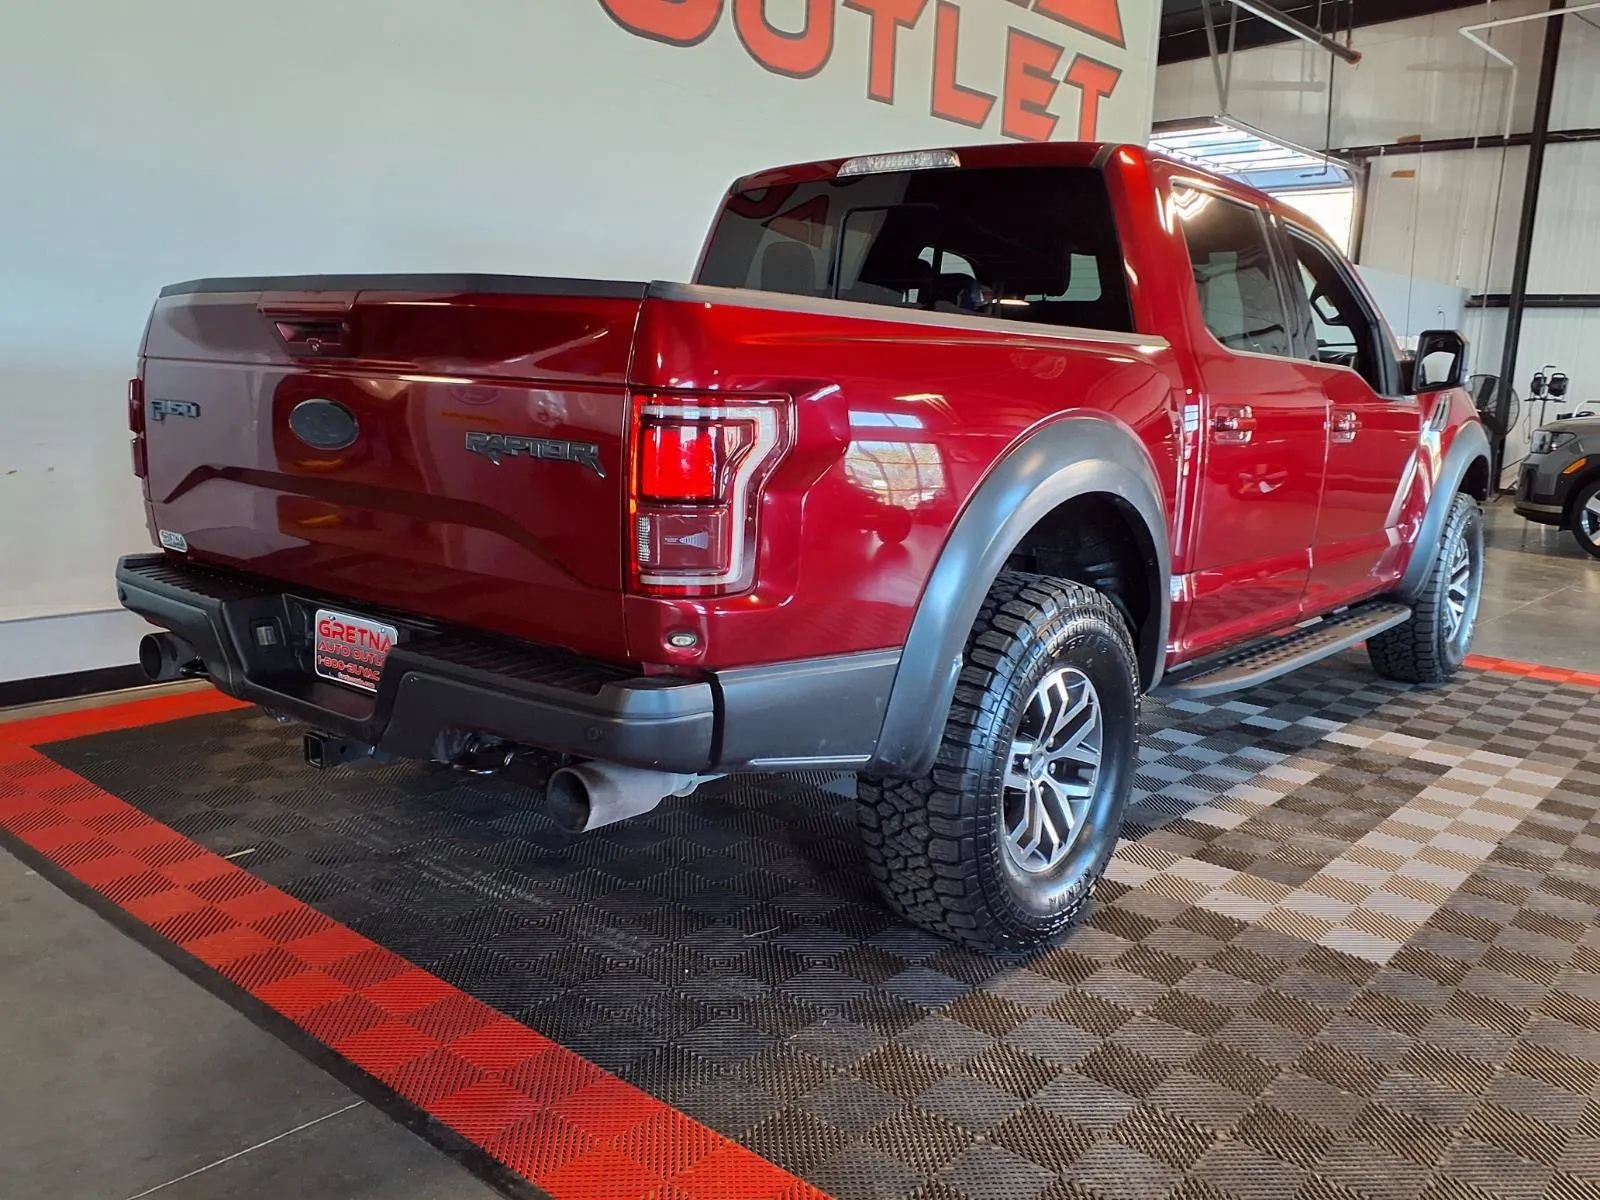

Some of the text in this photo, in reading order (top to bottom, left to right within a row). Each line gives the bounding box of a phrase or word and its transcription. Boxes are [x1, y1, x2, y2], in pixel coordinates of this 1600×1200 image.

[465, 431, 606, 479] RAPTOR
[318, 619, 392, 653] GRETNA
[319, 640, 350, 657] AUTO
